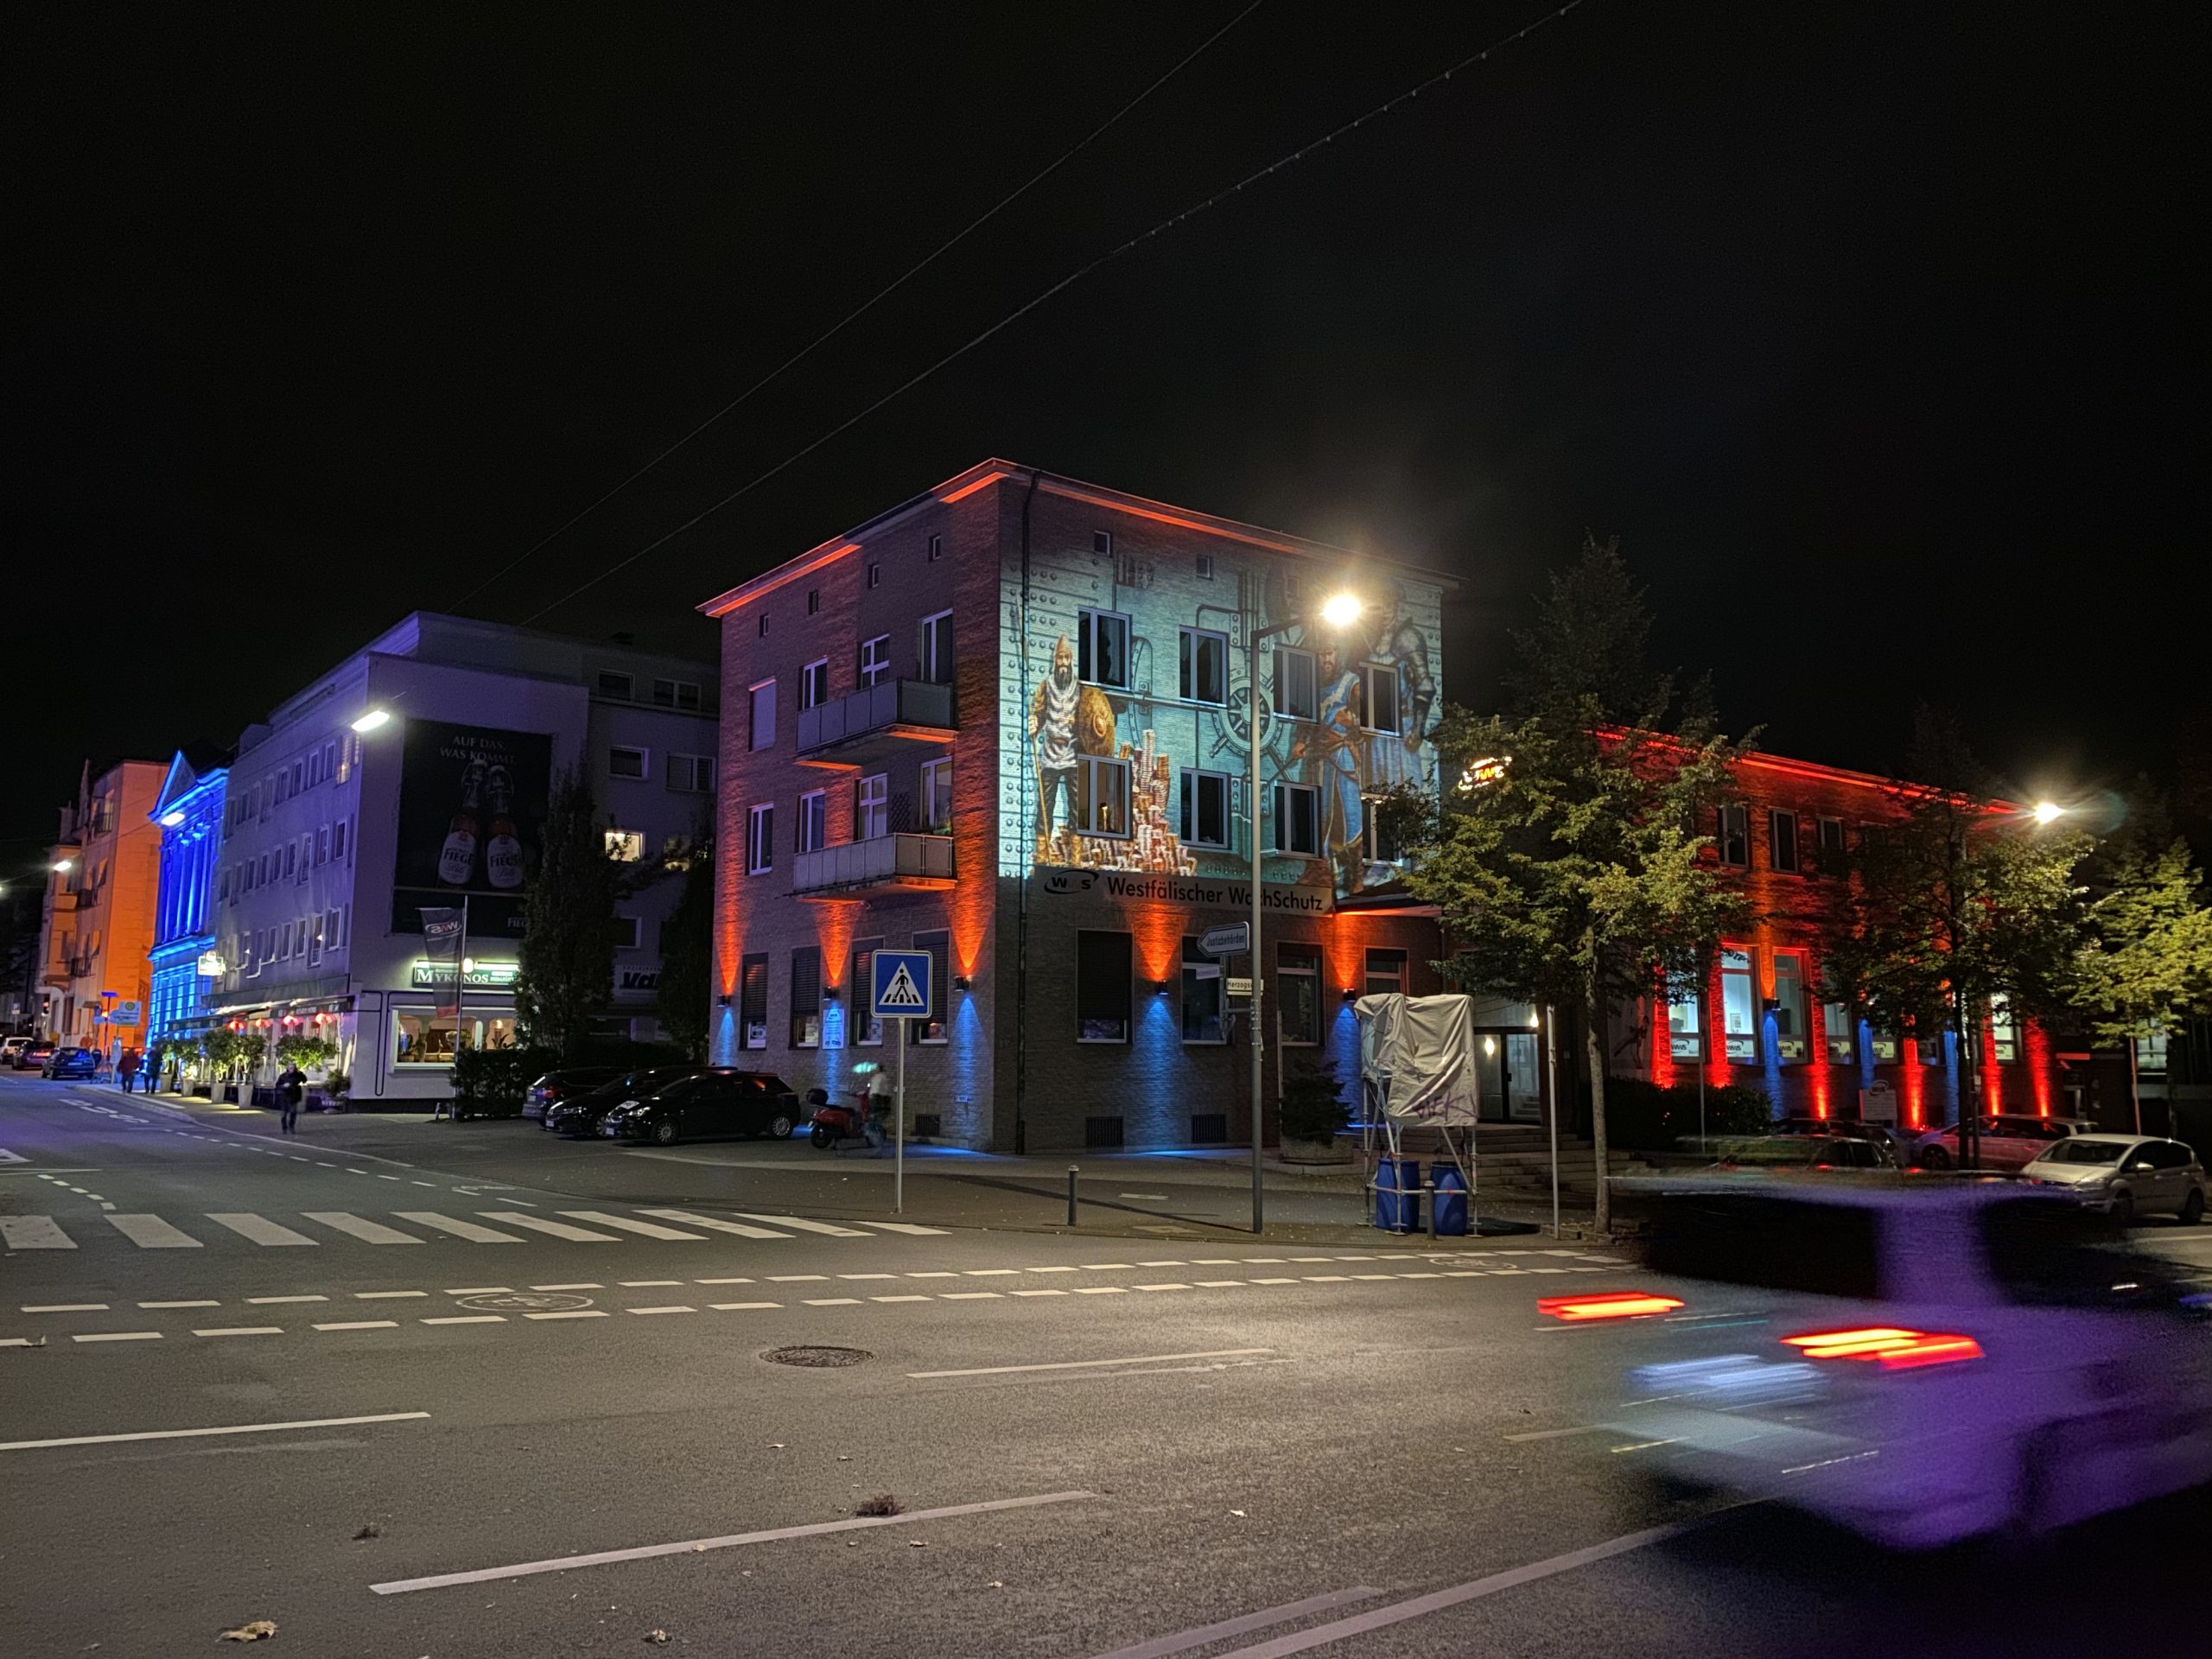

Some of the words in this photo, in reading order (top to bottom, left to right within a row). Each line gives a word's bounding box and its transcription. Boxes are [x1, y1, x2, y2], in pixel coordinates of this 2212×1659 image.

[453, 735, 477, 747] AUF
[440, 747, 467, 760] WAS
[443, 848, 475, 864] FIEGE
[1107, 876, 1224, 903] Westfälischer
[1228, 887, 1323, 911] WahSchutz
[620, 972, 658, 989] Vd
